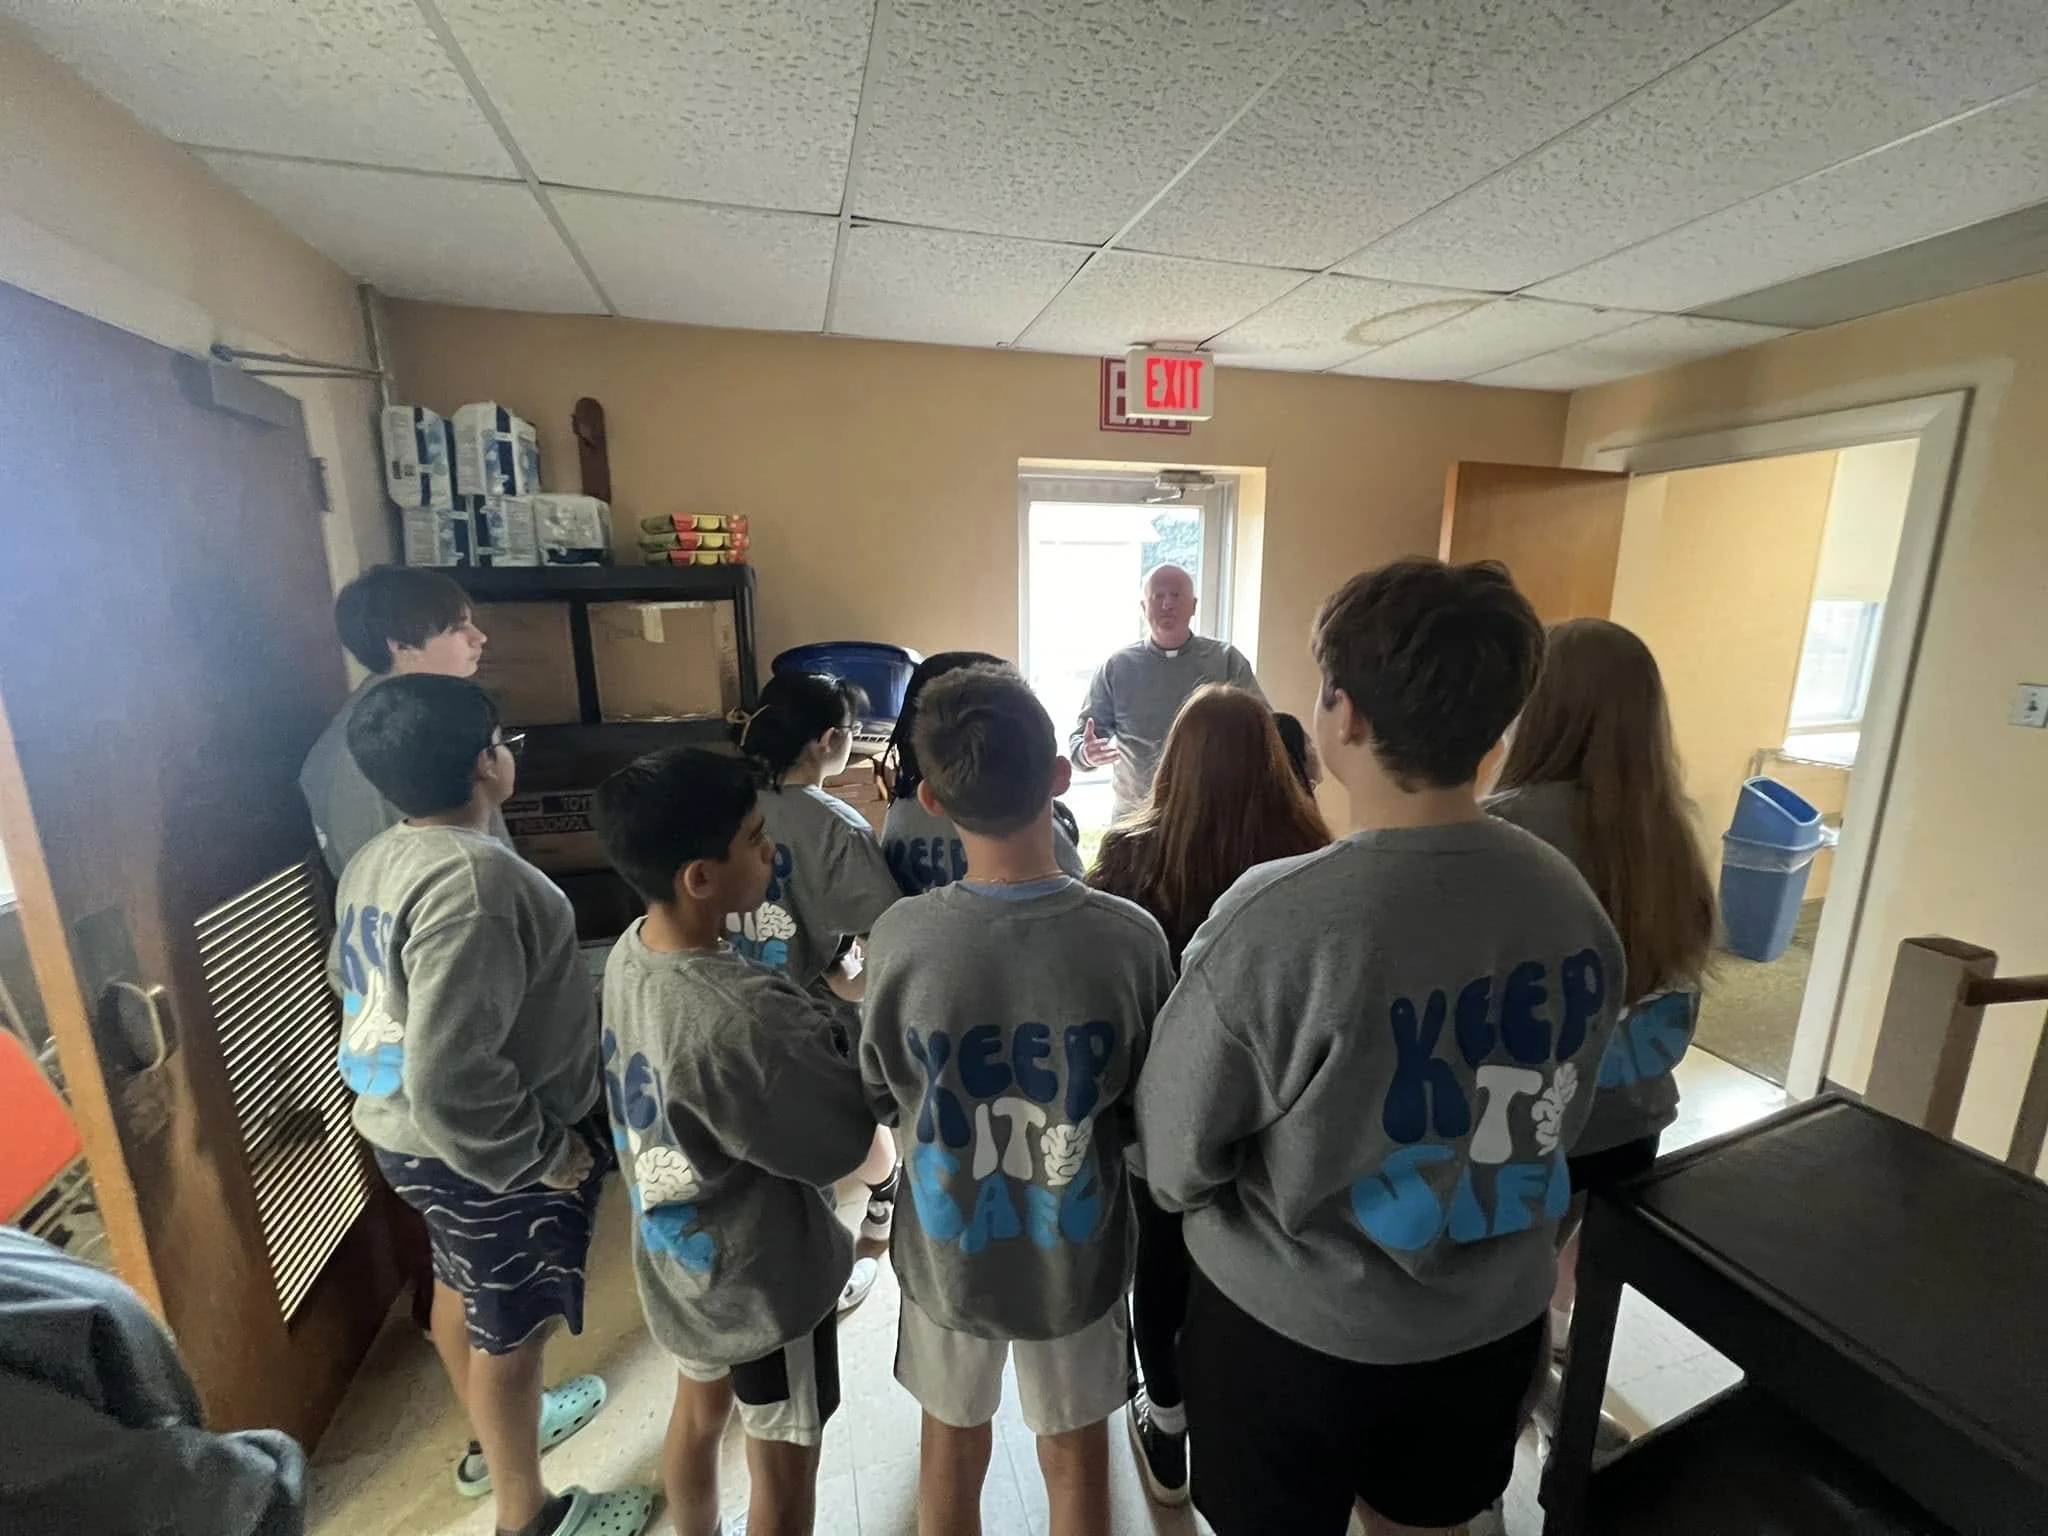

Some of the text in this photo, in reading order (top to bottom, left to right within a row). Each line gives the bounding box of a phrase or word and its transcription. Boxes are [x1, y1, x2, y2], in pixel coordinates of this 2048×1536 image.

[1146, 356, 1204, 411] EXIT
[907, 1021, 1115, 1148] KEEP
[1383, 949, 1604, 1143] KEEP
[972, 1097, 1047, 1181] IT
